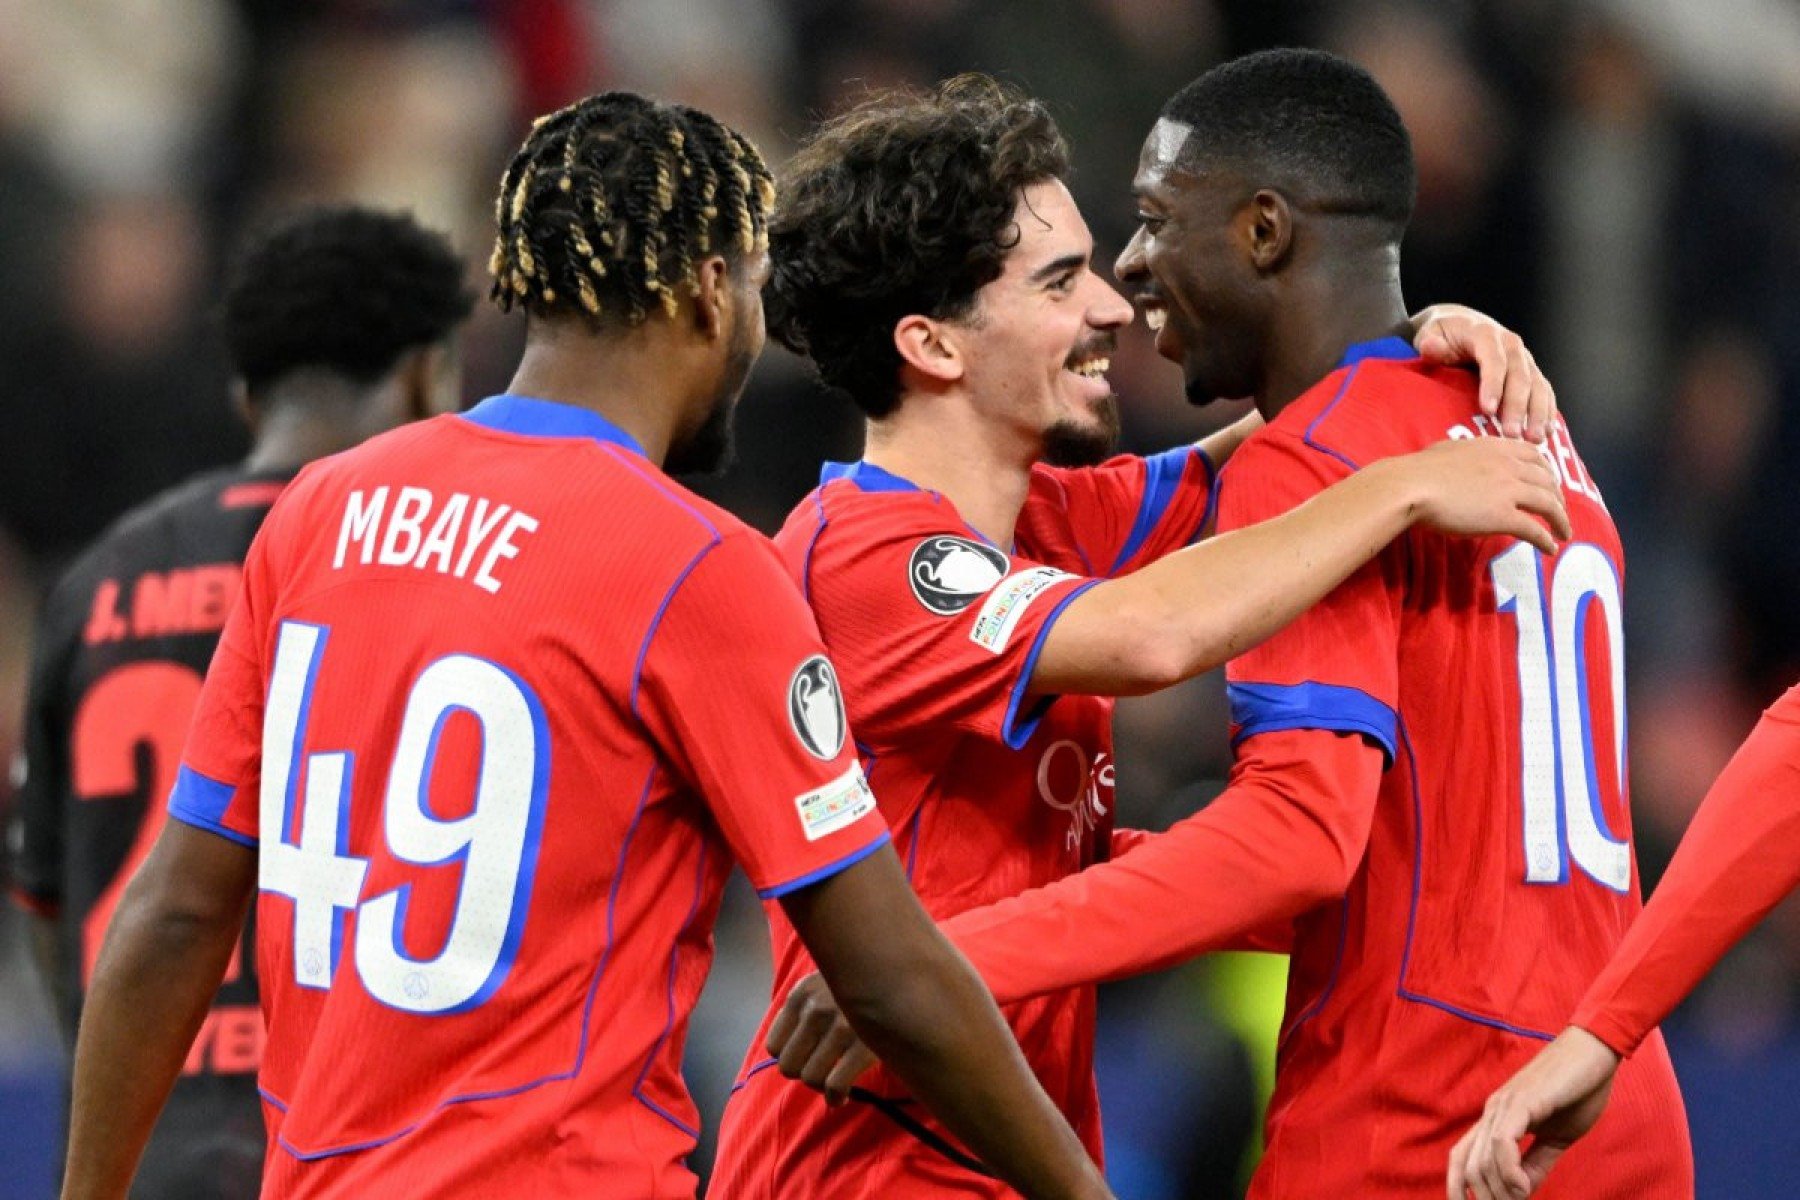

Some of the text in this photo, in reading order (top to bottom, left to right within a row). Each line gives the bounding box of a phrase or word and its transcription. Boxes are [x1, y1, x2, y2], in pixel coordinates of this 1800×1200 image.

[332, 485, 540, 596] MBAYE
[1489, 540, 1631, 895] 10
[258, 619, 552, 1017] 49
